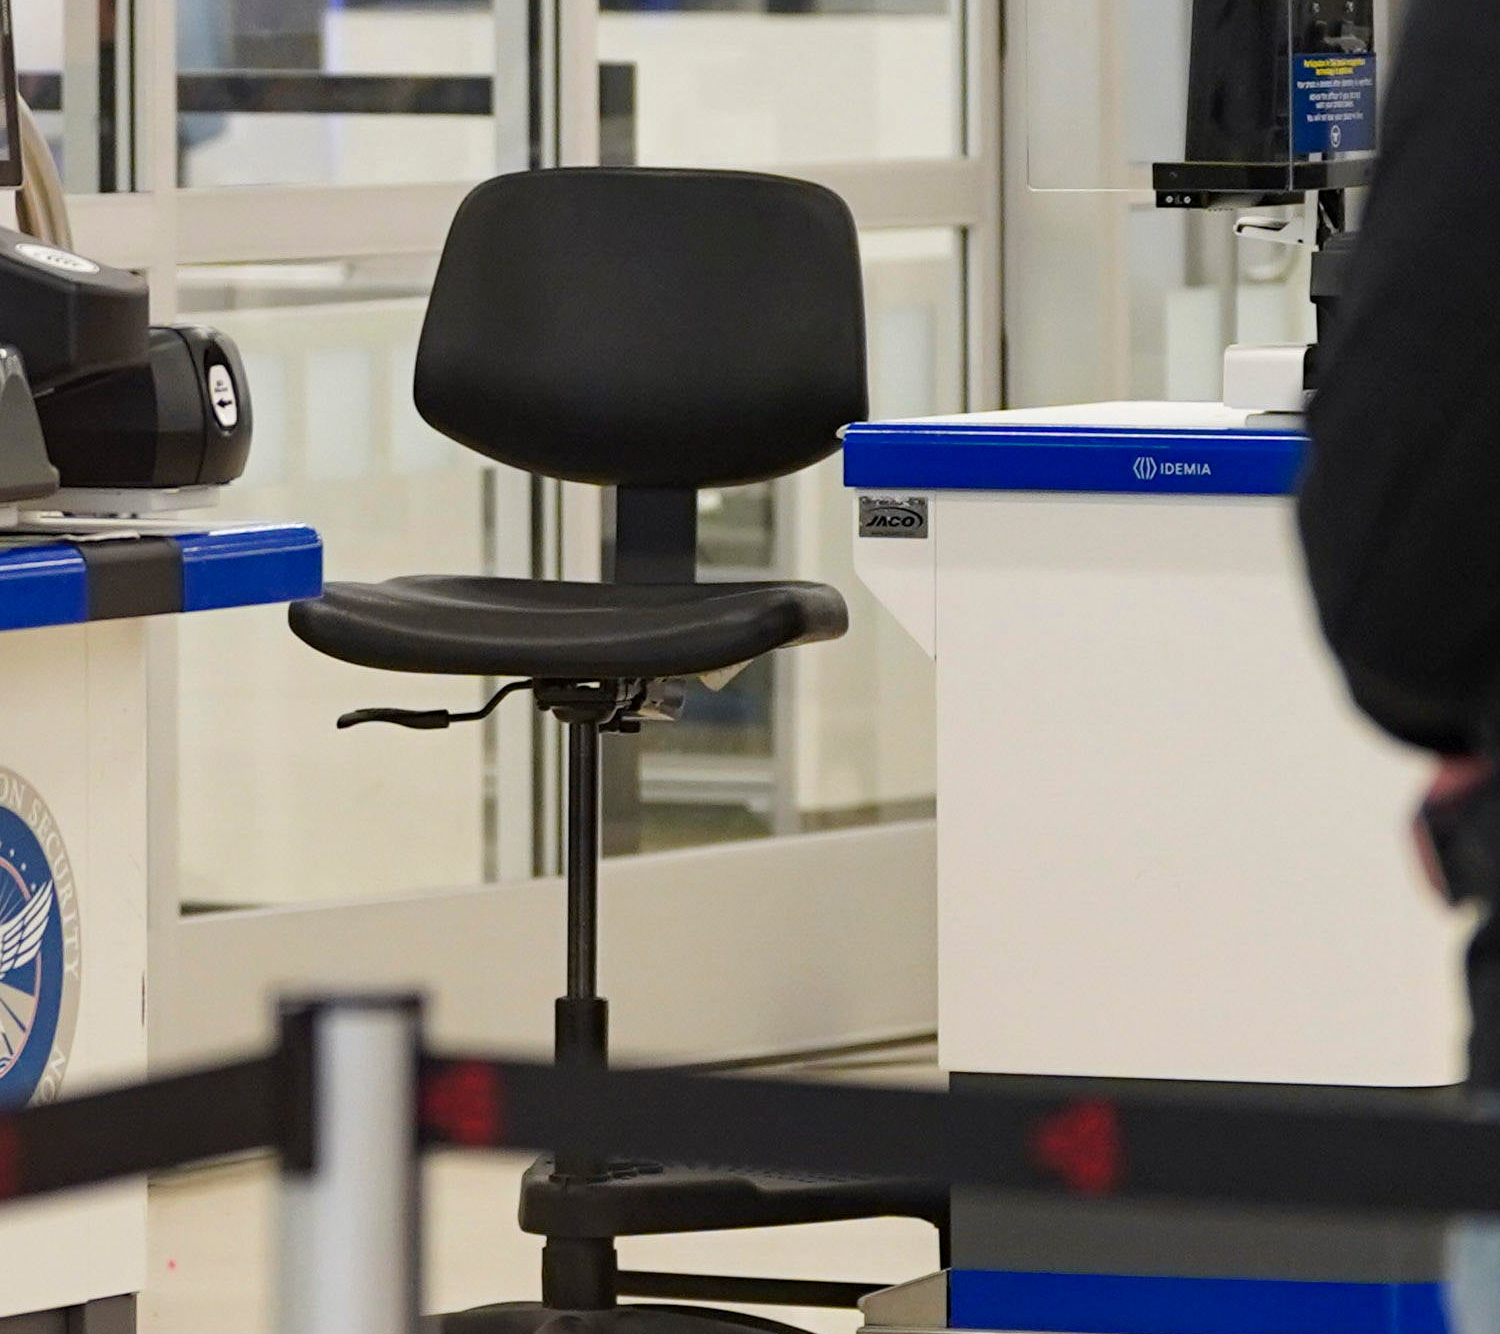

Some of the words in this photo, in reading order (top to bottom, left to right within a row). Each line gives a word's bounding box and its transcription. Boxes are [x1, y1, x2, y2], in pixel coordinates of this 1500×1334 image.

[1160, 462, 1212, 476] IDEMIA
[866, 516, 916, 527] JACO
[28, 798, 79, 982] SECURITY
